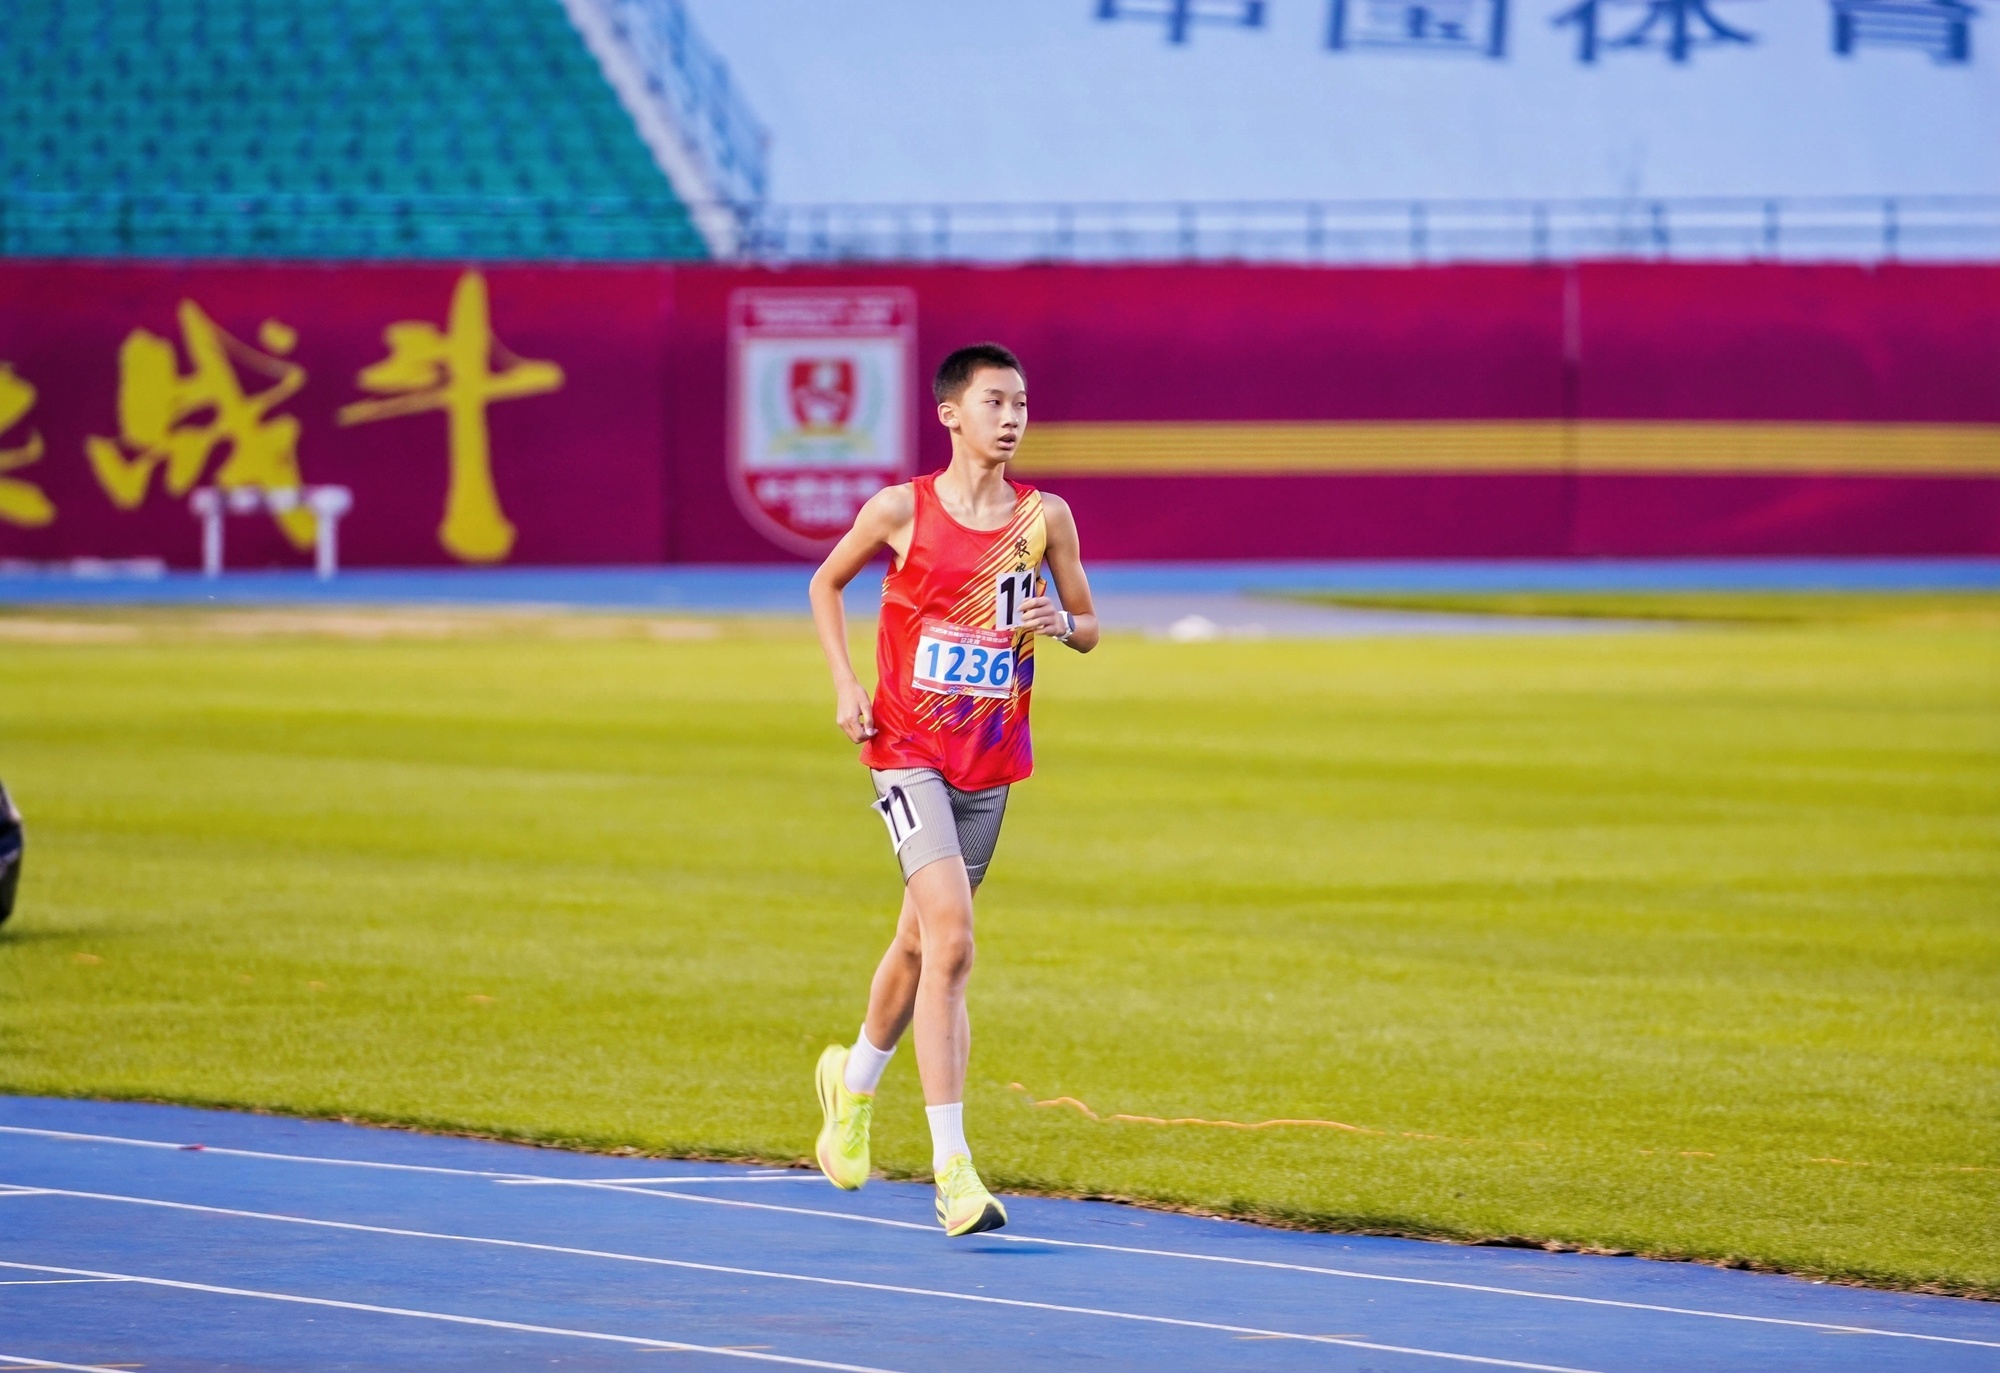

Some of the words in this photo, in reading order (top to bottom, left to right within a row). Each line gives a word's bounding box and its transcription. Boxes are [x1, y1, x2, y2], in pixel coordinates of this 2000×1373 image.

[1000, 572, 1032, 625] 11
[927, 643, 1010, 686] 1236
[881, 786, 916, 843] 11
